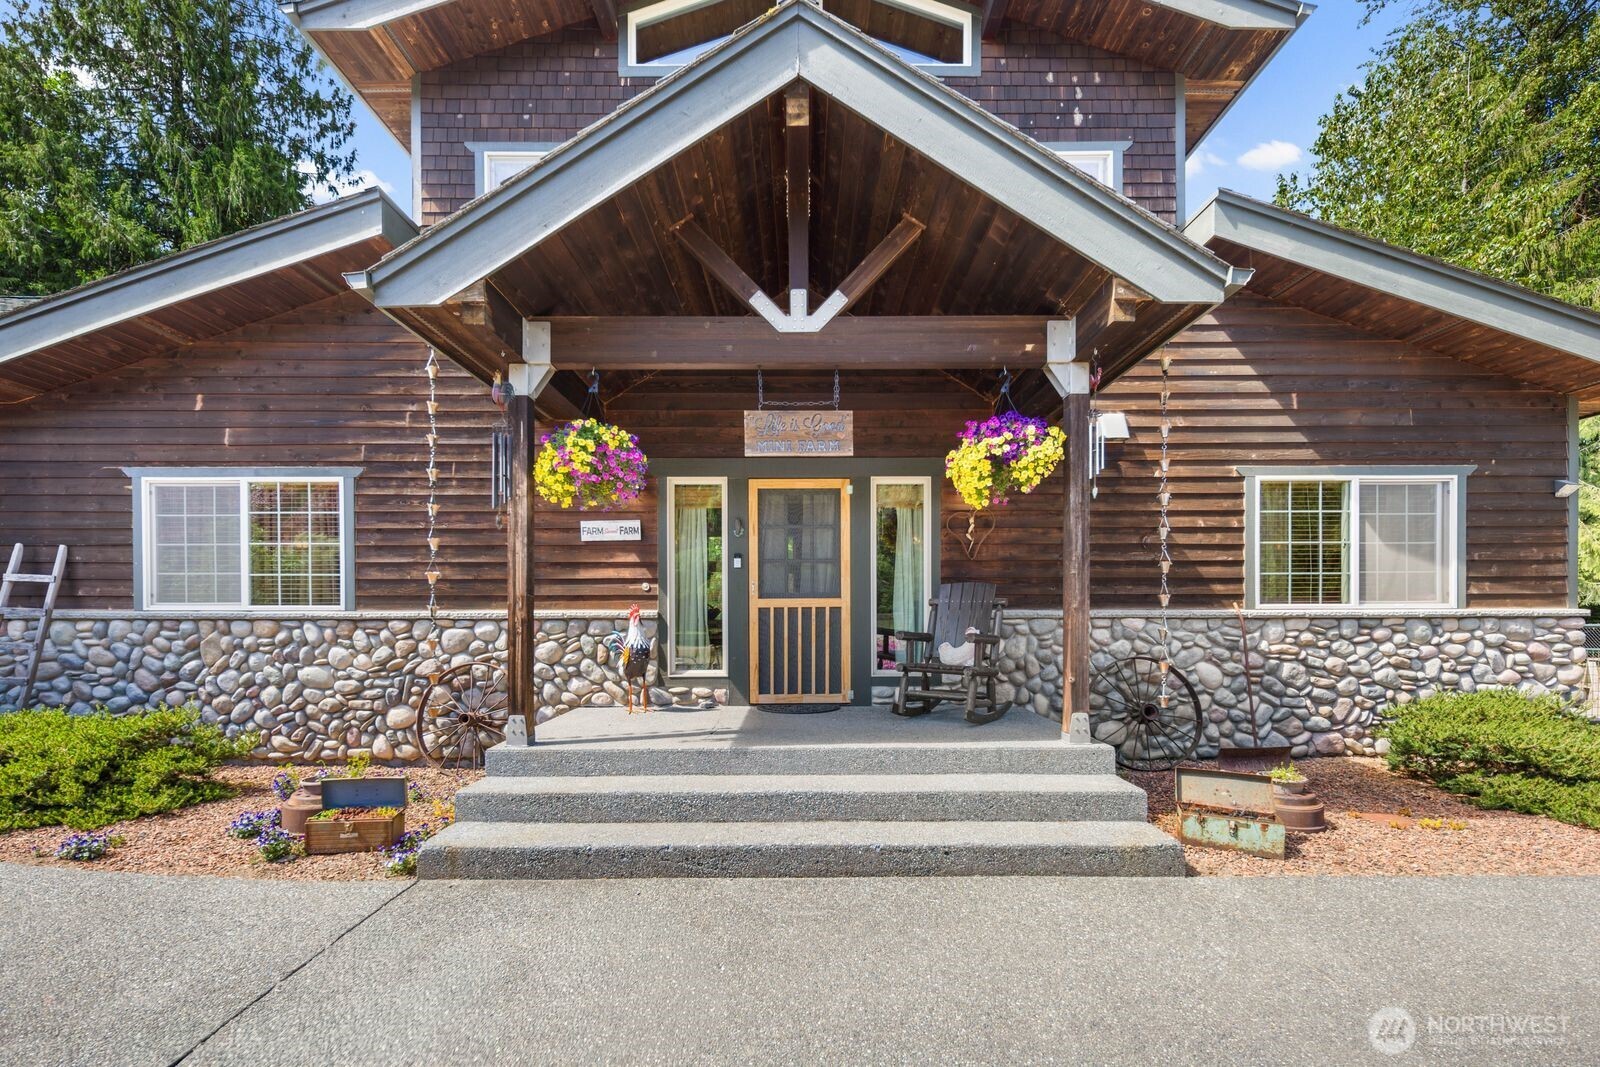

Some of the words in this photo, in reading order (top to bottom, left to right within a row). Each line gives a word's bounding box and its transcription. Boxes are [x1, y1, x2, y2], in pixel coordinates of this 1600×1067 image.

[790, 417, 799, 432] is
[757, 440, 792, 452] MINI
[798, 440, 840, 452] FARM
[582, 527, 604, 535] FARM
[619, 526, 640, 535] FARM
